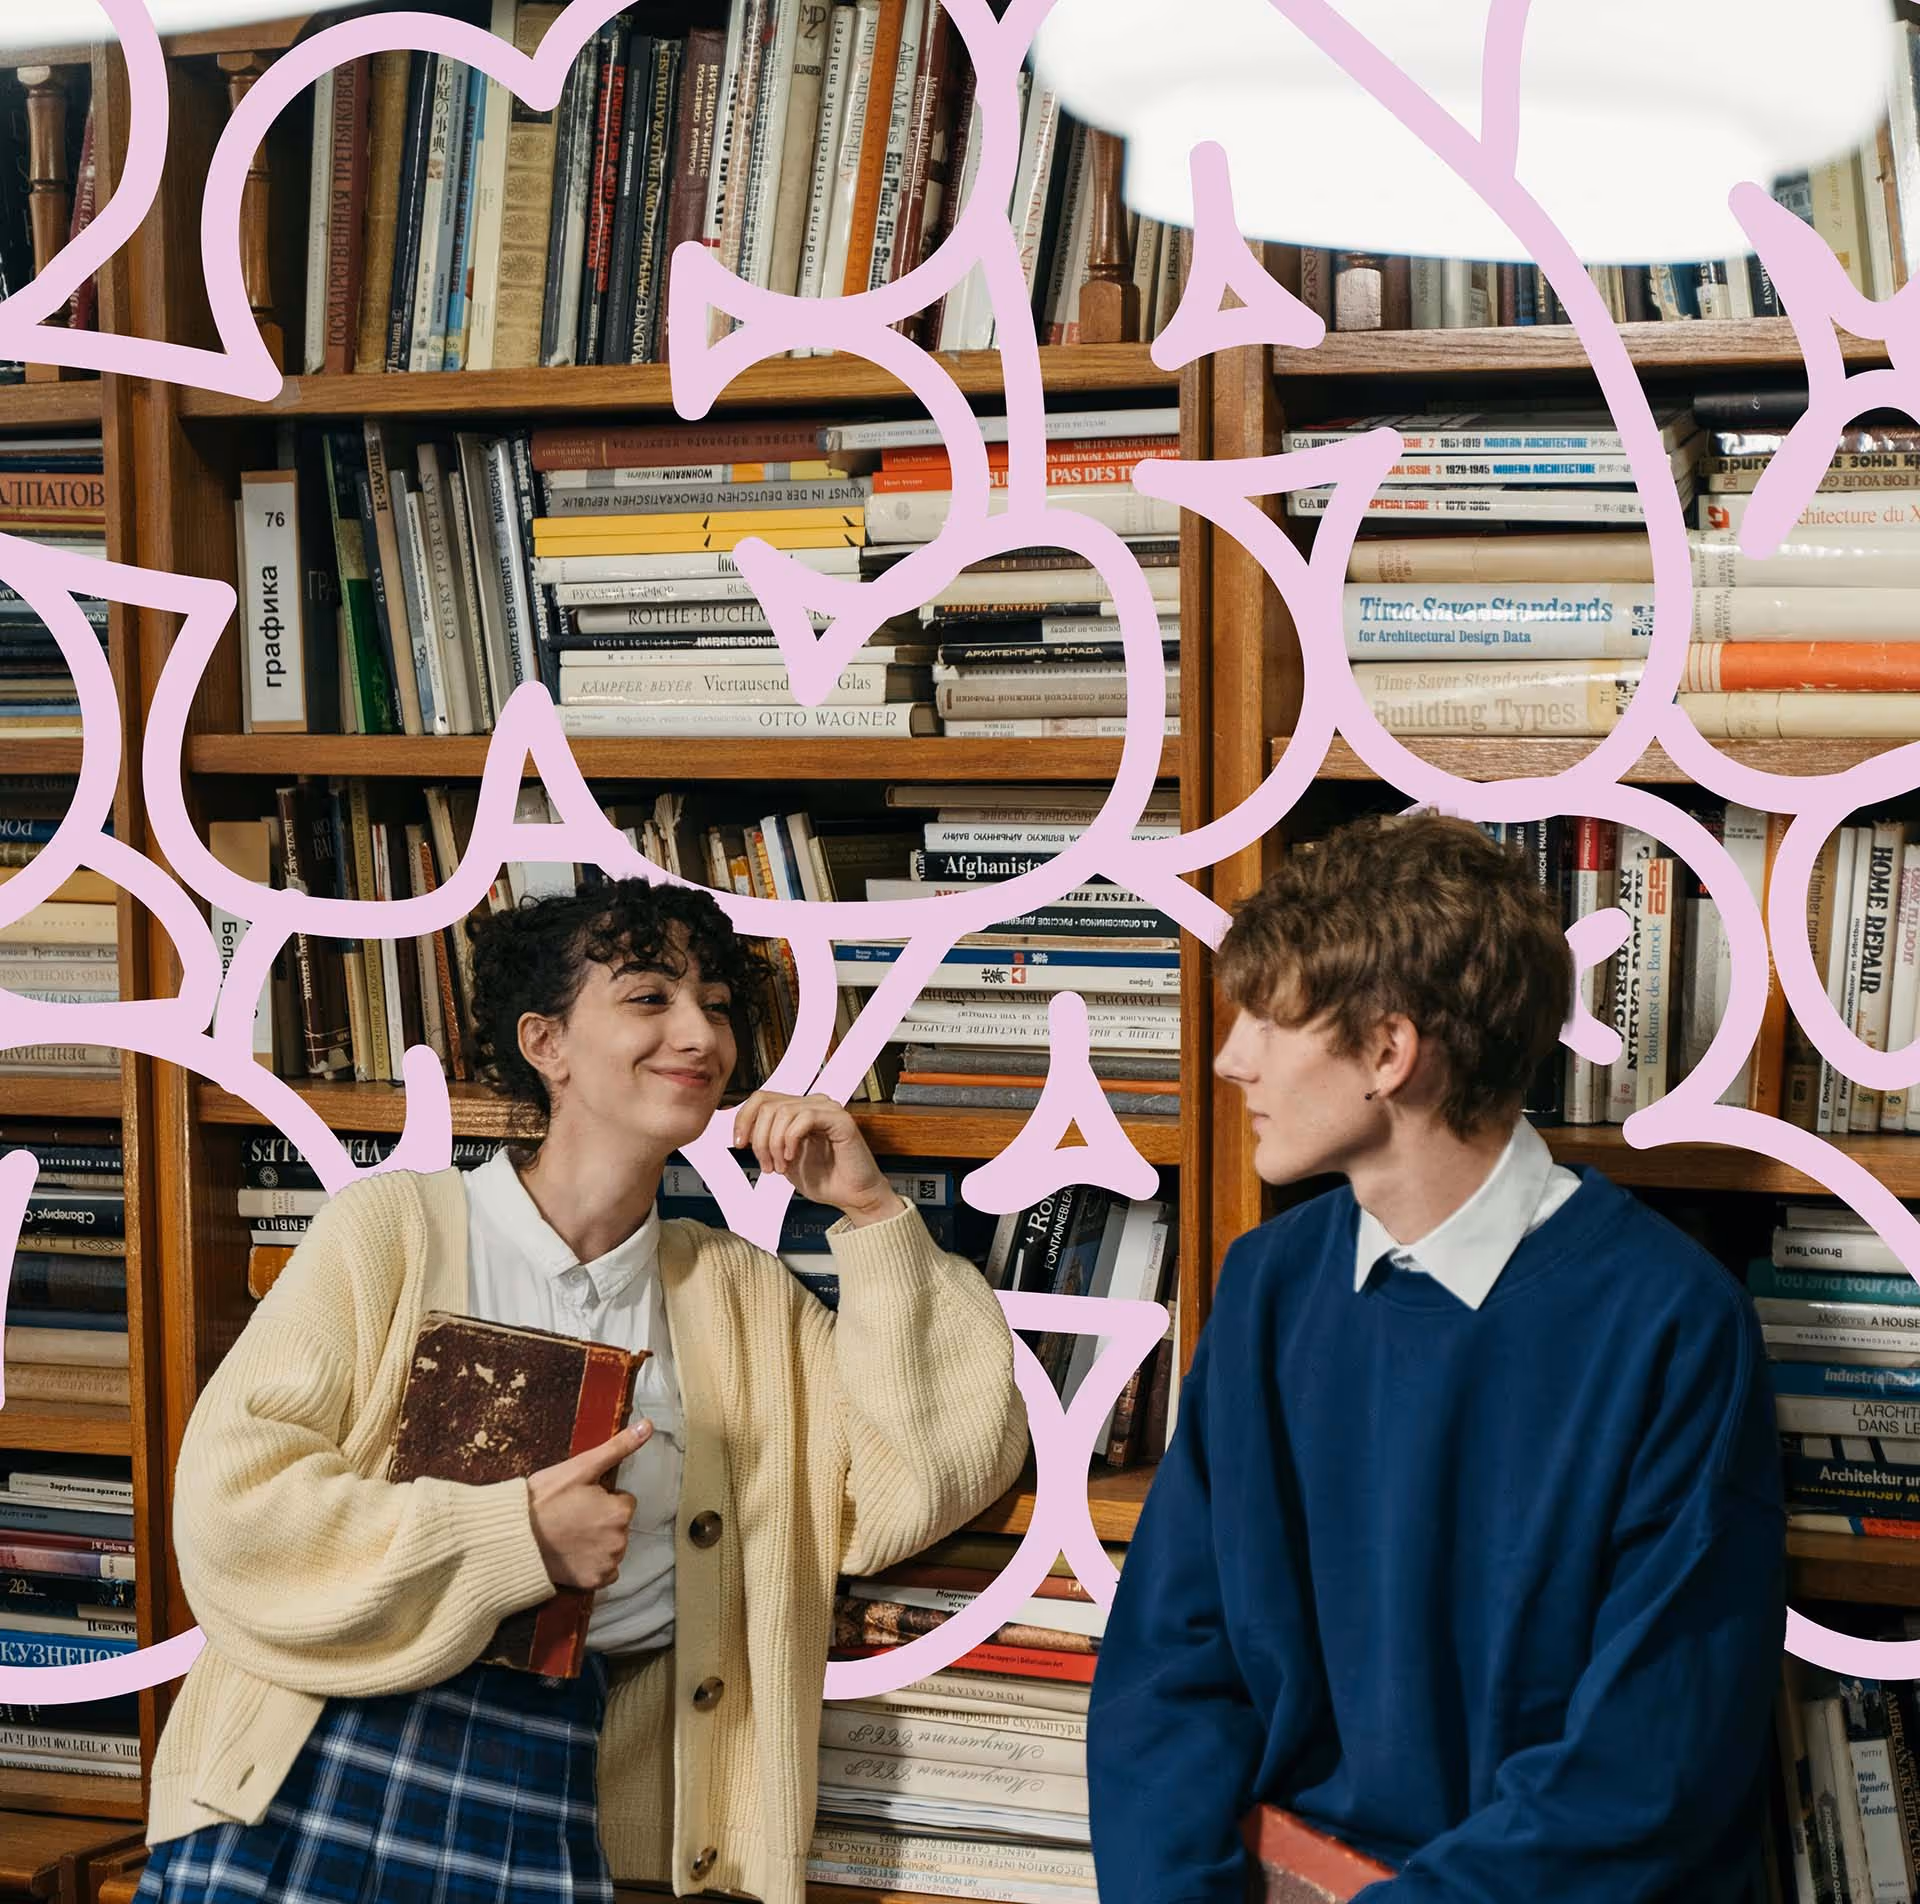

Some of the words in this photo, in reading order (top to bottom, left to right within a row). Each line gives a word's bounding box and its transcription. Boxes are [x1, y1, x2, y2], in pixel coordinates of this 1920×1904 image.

[888, 40, 915, 146] Allen/Mullins
[920, 76, 939, 118] Methods
[333, 62, 356, 182] ТРЕТЬЯКОВСК
[607, 66, 626, 161] PRINCIPLES
[699, 64, 719, 177] ЭНЦИКЛОПЕДИЯ
[804, 206, 822, 278] moderne
[828, 20, 845, 85] malerei
[884, 151, 903, 174] Ein
[912, 141, 930, 188] Materials
[878, 177, 900, 218] Platz
[1440, 438, 1481, 449] 1851-1919
[1523, 437, 1588, 448] ARCHITECTURE
[1051, 466, 1083, 484] PAS
[1085, 465, 1117, 482] DES
[1492, 463, 1531, 475] MODERN
[1533, 463, 1596, 475] ARCHITECTURE
[0, 480, 105, 508] ЛПАТОВ
[487, 457, 506, 523] MARSCHAK
[718, 489, 783, 505] DEUTSCHEN
[786, 488, 808, 503] DER
[811, 487, 825, 502] IN
[828, 486, 865, 501] KUNST
[561, 496, 610, 509] REPUBLIK
[613, 492, 714, 508] DEMOKRATISCHEN
[264, 511, 285, 527] 76
[1883, 504, 1905, 522] du
[499, 556, 514, 604] ORIENTS
[505, 605, 518, 629] DES
[1489, 597, 1613, 623] Standards
[259, 565, 286, 688] графика
[1358, 629, 1375, 644] for
[1378, 629, 1456, 644] Architectural
[1458, 630, 1501, 646] Design
[1503, 630, 1532, 644] Data
[1053, 647, 1104, 656] ЗАПАДА
[703, 673, 789, 692] Viertausend
[837, 675, 872, 691] Glas
[758, 710, 807, 727] OTTO
[815, 710, 898, 728] WAGNER
[1494, 698, 1578, 732] Types
[941, 832, 970, 843] ВАЙНУ
[1867, 846, 1894, 910] HOME
[1646, 924, 1662, 973] Barock
[1859, 915, 1887, 995] REPAIR
[1848, 960, 1856, 972] im
[1644, 976, 1660, 999] des
[1643, 1001, 1660, 1066] Baukunst
[257, 1218, 313, 1232] ENBILD
[1784, 1244, 1809, 1257] Taut
[1809, 1245, 1844, 1259] Bruno
[1846, 1276, 1884, 1294] Your
[1870, 1317, 1880, 1328] A
[1882, 1317, 1920, 1330] HOUSE
[1857, 1418, 1900, 1434] DANS
[1820, 1465, 1903, 1487] Architektur
[947, 1685, 1025, 1702] HUNGARIAN
[1012, 1718, 1082, 1736] скульптура
[1856, 1770, 1877, 1782] With
[1859, 1781, 1890, 1793] Benefit
[1861, 1794, 1870, 1805] of
